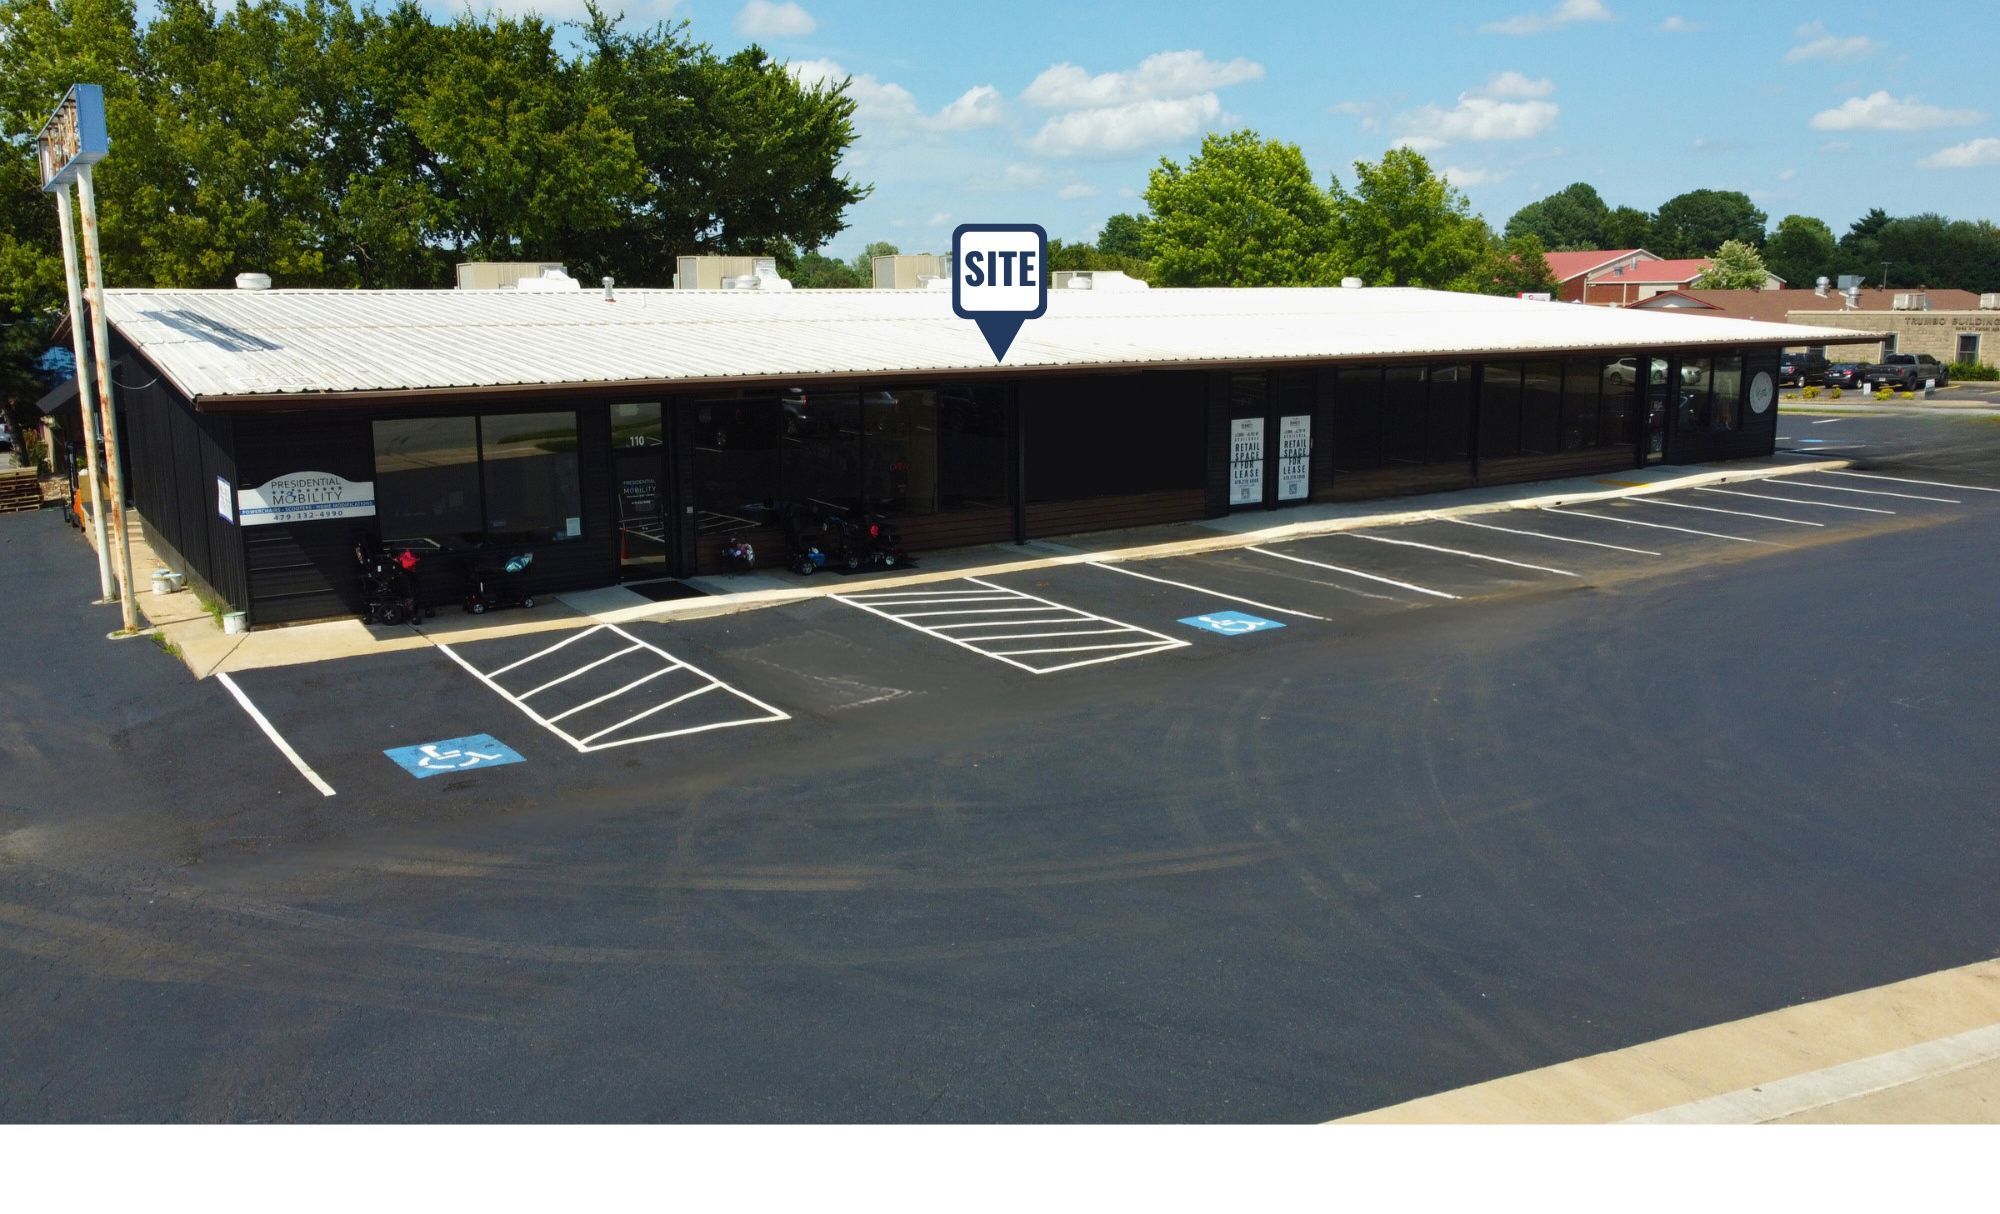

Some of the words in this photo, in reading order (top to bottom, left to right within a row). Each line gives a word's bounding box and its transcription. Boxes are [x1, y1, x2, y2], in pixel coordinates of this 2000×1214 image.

[1905, 317, 1946, 326] TRUMBO
[629, 436, 645, 446] 110
[1284, 439, 1306, 449] RETAIL
[1235, 442, 1260, 452] RETAIL
[1235, 451, 1260, 461] SPACE
[1284, 448, 1306, 458] SPACE
[1240, 460, 1254, 469] FOR
[1289, 456, 1301, 466] FOR
[1234, 469, 1259, 479] LEASE
[1283, 465, 1305, 475] LEASE
[271, 478, 342, 489] PRESIDENTIAL
[624, 486, 656, 494] MOBILITY
[272, 490, 343, 506] MOBILITY
